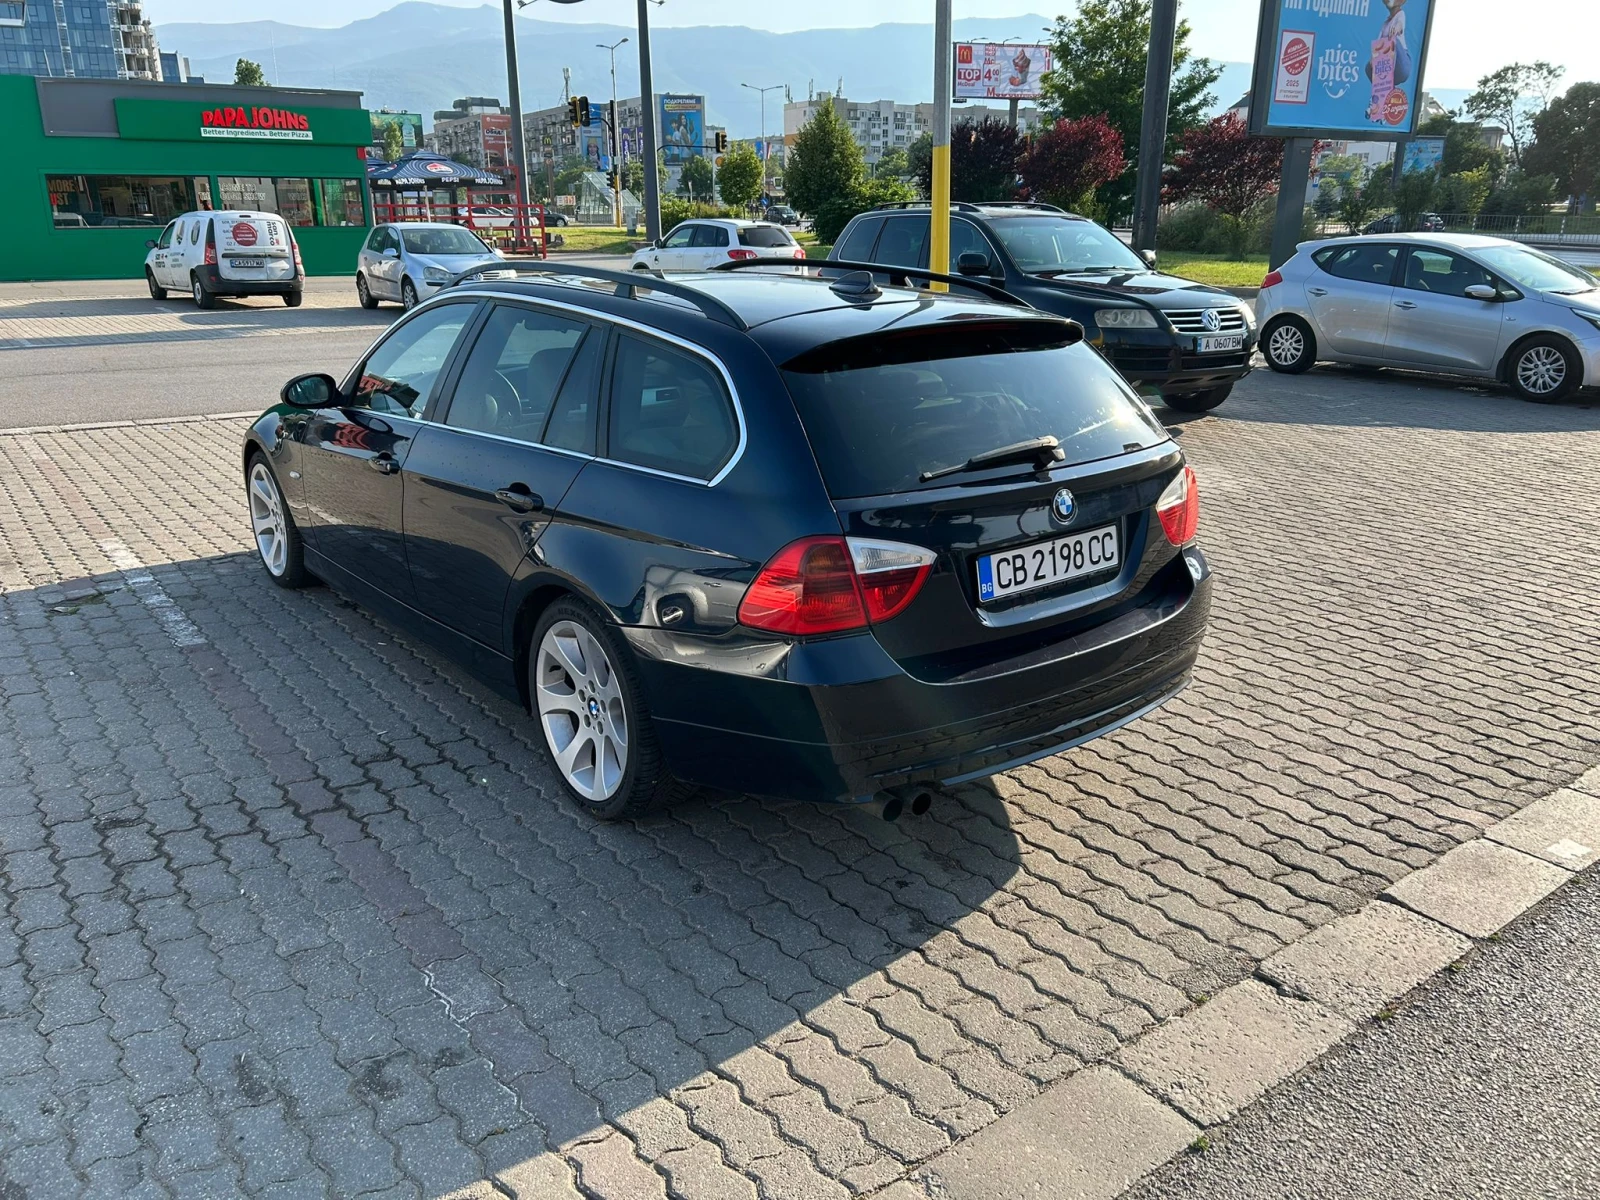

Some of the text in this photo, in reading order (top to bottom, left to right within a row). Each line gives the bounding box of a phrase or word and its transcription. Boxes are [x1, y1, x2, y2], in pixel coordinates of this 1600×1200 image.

[1323, 44, 1357, 67] nice
[960, 69, 980, 80] TOP
[1317, 56, 1359, 83] bites
[1286, 79, 1299, 87] 2025
[202, 107, 309, 130] PAPA JOHNS
[226, 129, 268, 138] Ingredients.
[48, 179, 76, 193] MORE
[266, 221, 275, 246] marco
[1205, 339, 1210, 350] A
[1214, 338, 1231, 349] 0607
[996, 532, 1114, 589] CB 2198 CC
[981, 582, 993, 594] BG
